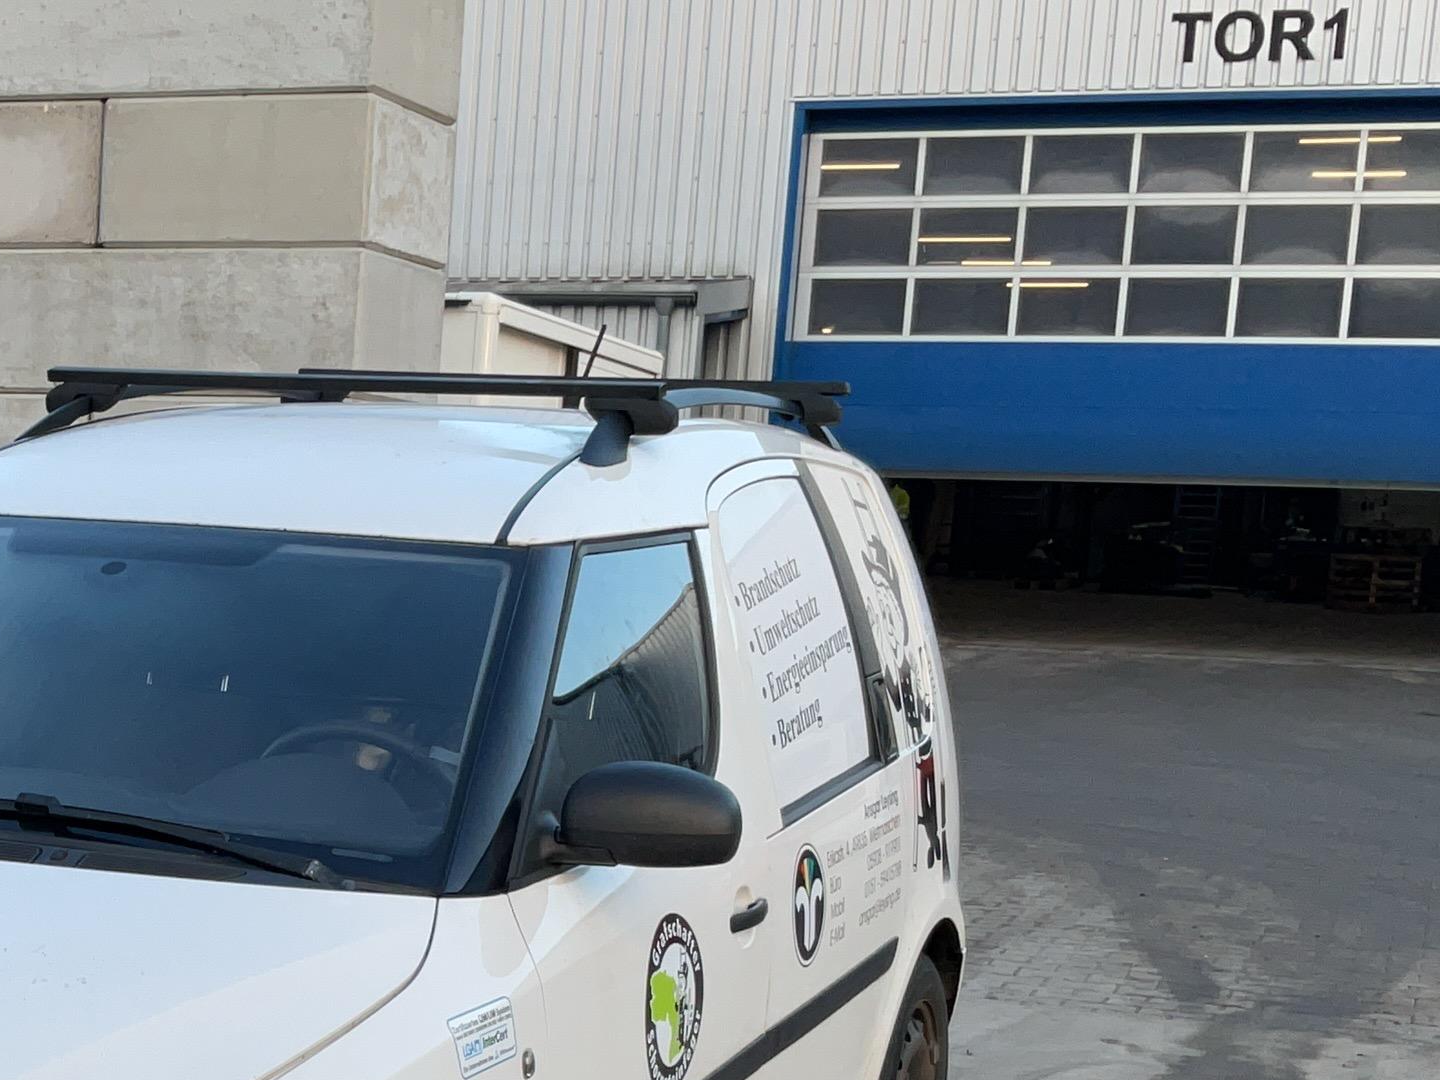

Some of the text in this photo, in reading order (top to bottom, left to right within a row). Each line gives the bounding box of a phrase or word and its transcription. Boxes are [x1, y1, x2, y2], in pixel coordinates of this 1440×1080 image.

[738, 557, 801, 612] Brandschutz
[753, 596, 821, 656] Umweltschutz
[766, 625, 852, 704] Energieeinsparung
[777, 699, 824, 749] Beratung
[652, 917, 701, 972] Grafschafter
